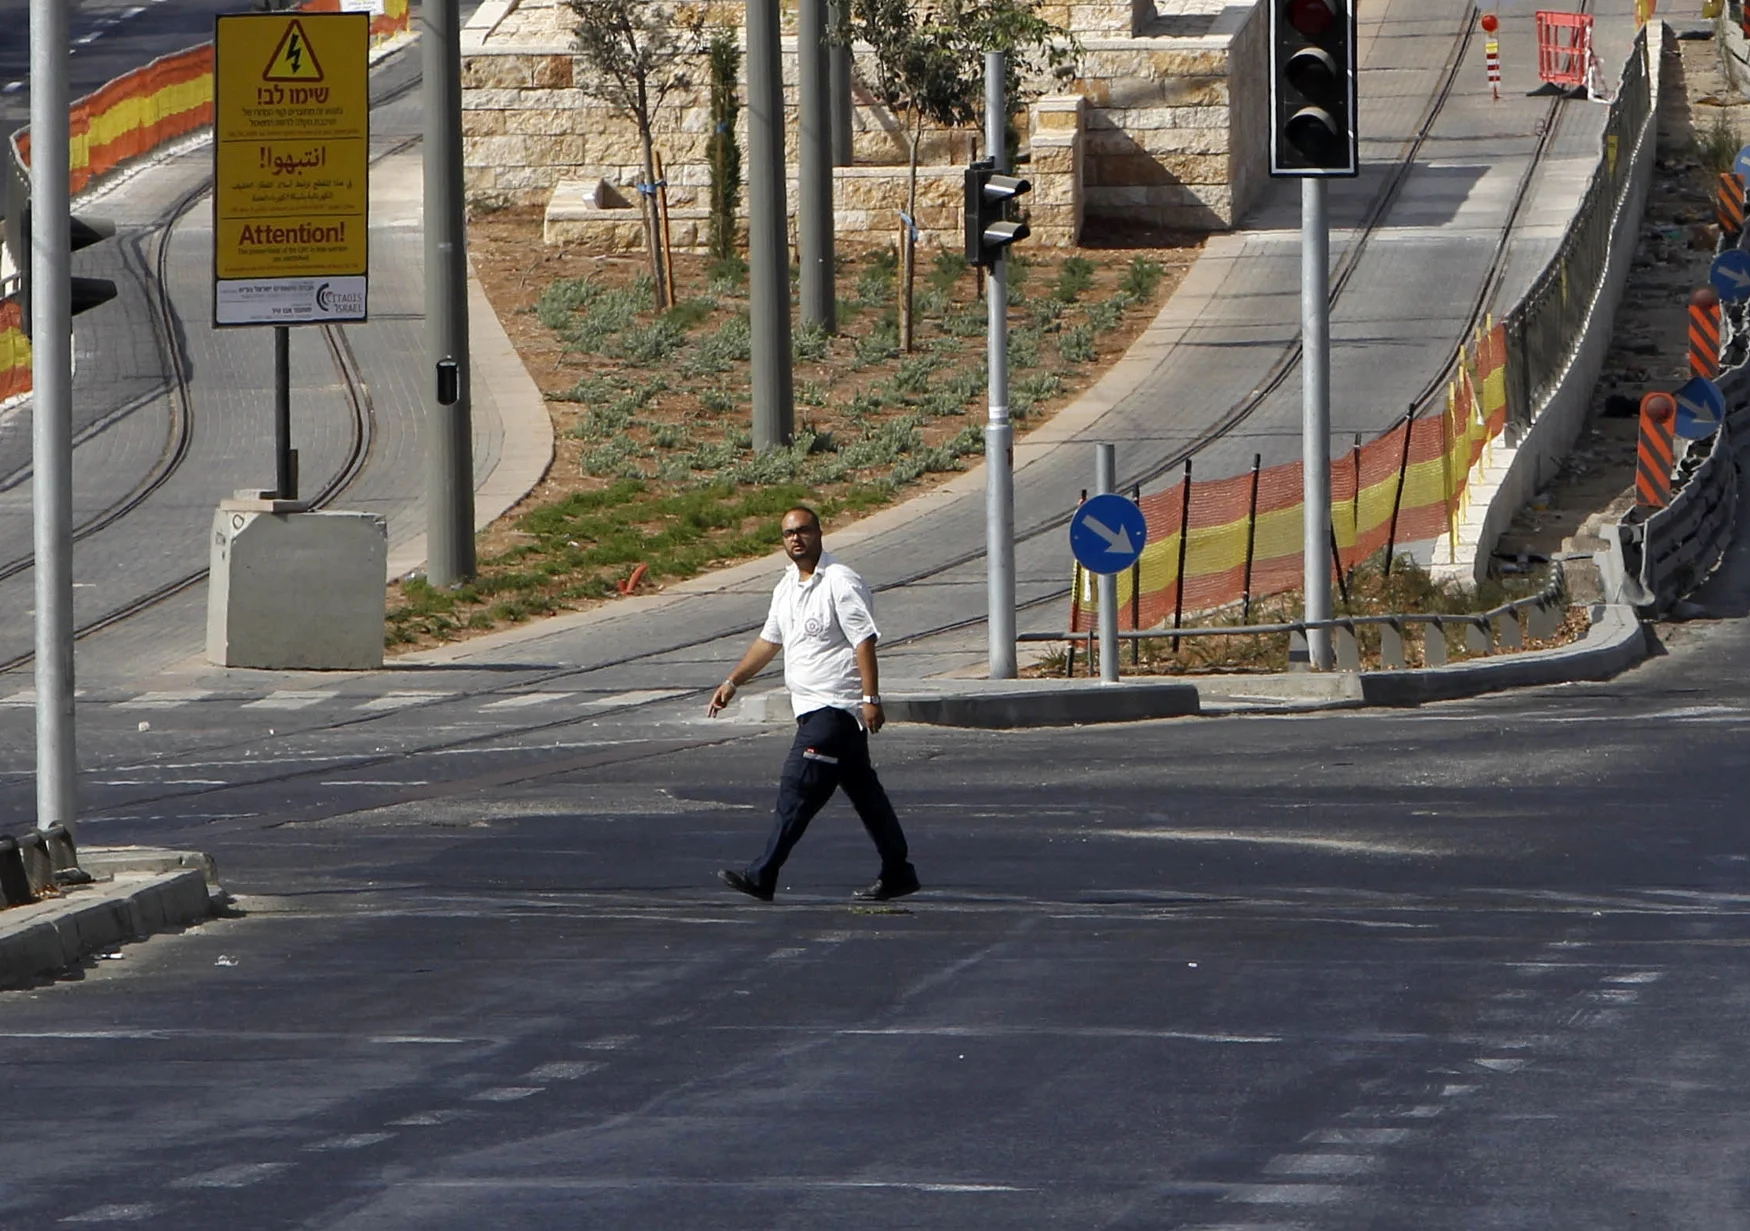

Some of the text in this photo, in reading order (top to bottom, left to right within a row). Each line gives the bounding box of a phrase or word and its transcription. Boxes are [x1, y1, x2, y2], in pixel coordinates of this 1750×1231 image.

[257, 84, 329, 105] שימו לב!
[260, 146, 326, 175] انتبهوا!
[238, 221, 346, 246] Attention!
[326, 292, 362, 303] CITADIS
